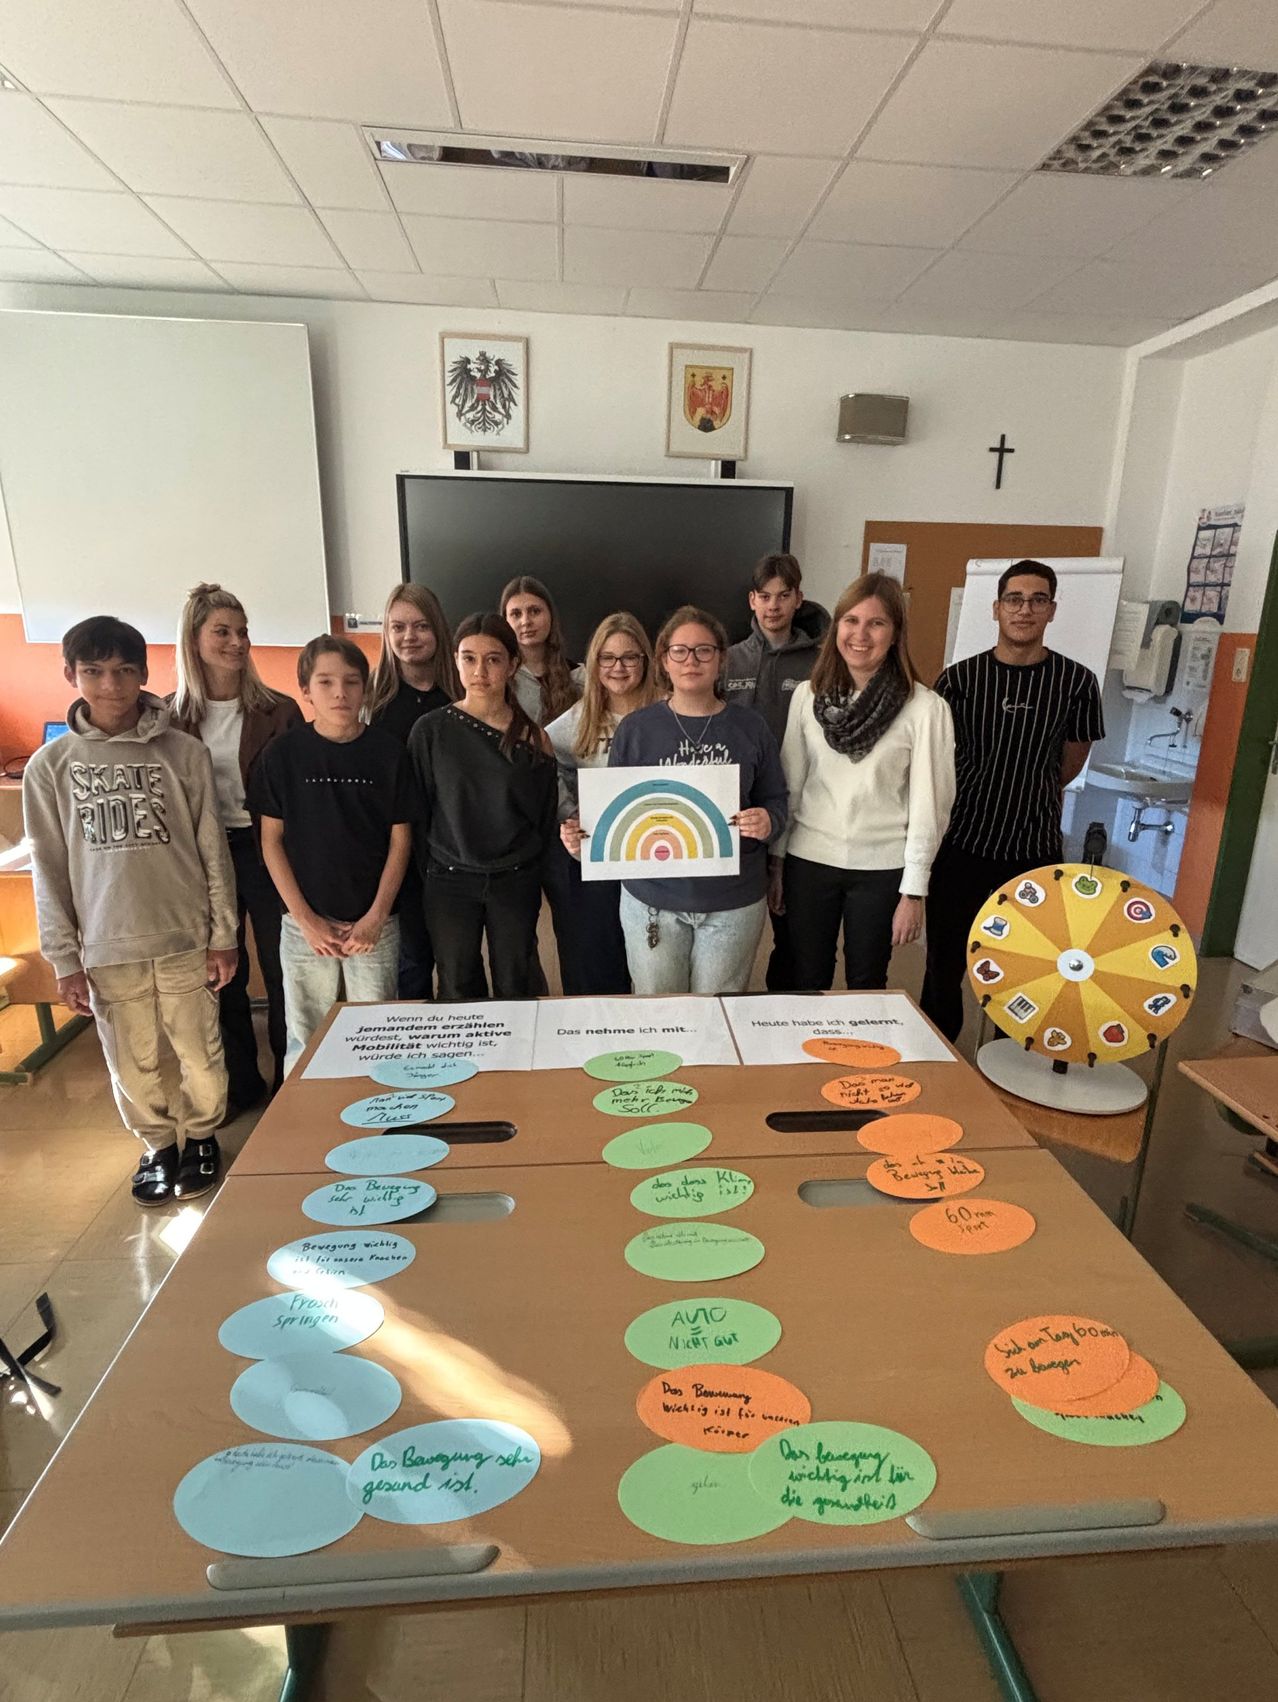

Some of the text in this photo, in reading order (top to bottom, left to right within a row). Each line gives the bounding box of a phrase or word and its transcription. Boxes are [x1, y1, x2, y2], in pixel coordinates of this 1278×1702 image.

[70, 761, 164, 800] SKATE
[77, 794, 171, 844] RIDES
[386, 1012, 485, 1023] Wenn du heute
[848, 1018, 904, 1027] gelernt,
[356, 1020, 505, 1034] jemandem erzählen
[556, 1026, 697, 1036] Das nehme ich mit...
[344, 1028, 512, 1042] würdest, warum aktive
[352, 1038, 498, 1052] Mobilität wichtig ist,
[359, 1049, 485, 1062] würde ich sagen...
[612, 1096, 650, 1104] mehr
[840, 1088, 870, 1098] nicht
[366, 1103, 420, 1112] machen
[656, 1186, 704, 1203] wichtig
[945, 1206, 972, 1224] 60
[302, 1240, 398, 1252] Bewegung wichtig
[290, 1294, 338, 1311] Frosch
[671, 1307, 727, 1328] AUTO
[714, 1332, 739, 1348] GUT
[662, 1381, 684, 1396] Das
[714, 1406, 730, 1416] ist
[738, 1408, 755, 1420] für
[703, 1426, 750, 1439] Körper
[371, 1446, 534, 1472] Das Bewegung sehr
[788, 1464, 849, 1492] wichtig
[362, 1472, 478, 1504] gesund ist.
[780, 1484, 803, 1507] die
